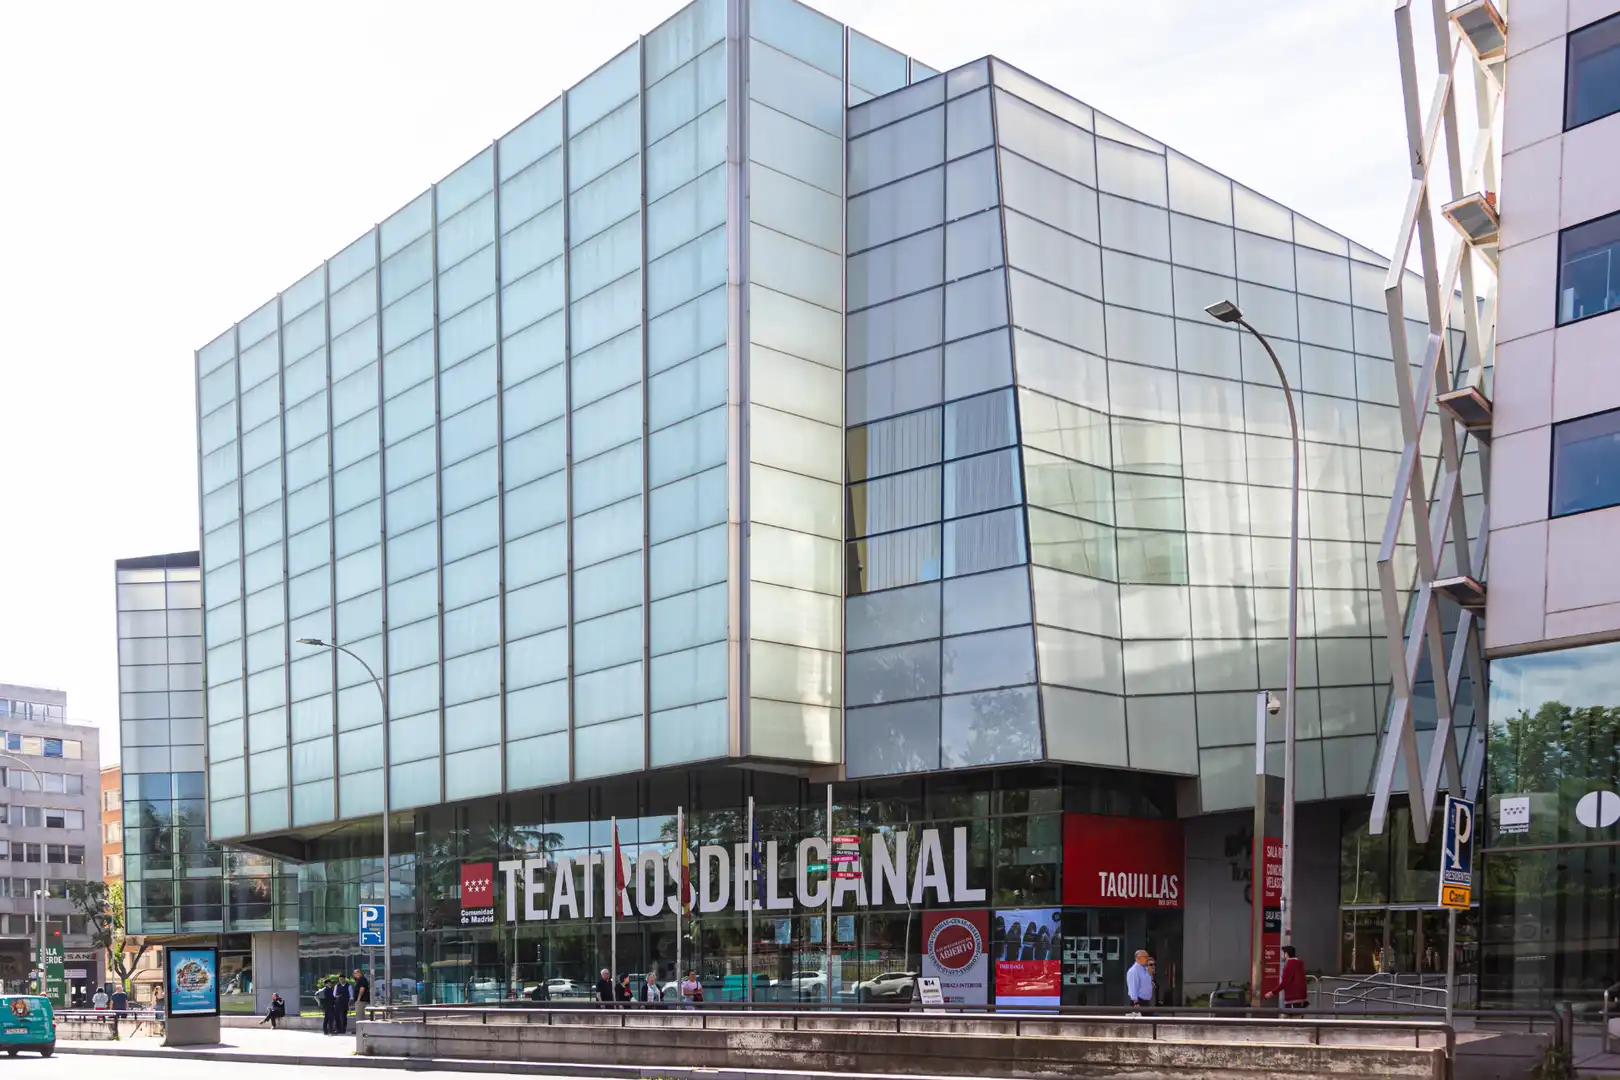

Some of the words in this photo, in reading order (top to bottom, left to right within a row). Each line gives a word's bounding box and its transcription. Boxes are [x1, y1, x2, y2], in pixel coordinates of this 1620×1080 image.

[1450, 802, 1472, 870] P
[1098, 871, 1178, 899] TAQUILLAS
[361, 907, 378, 929] P
[460, 916, 470, 924] de
[471, 915, 494, 923] Madrid
[461, 908, 494, 916] Comunidad
[939, 941, 973, 960] ABIERTO
